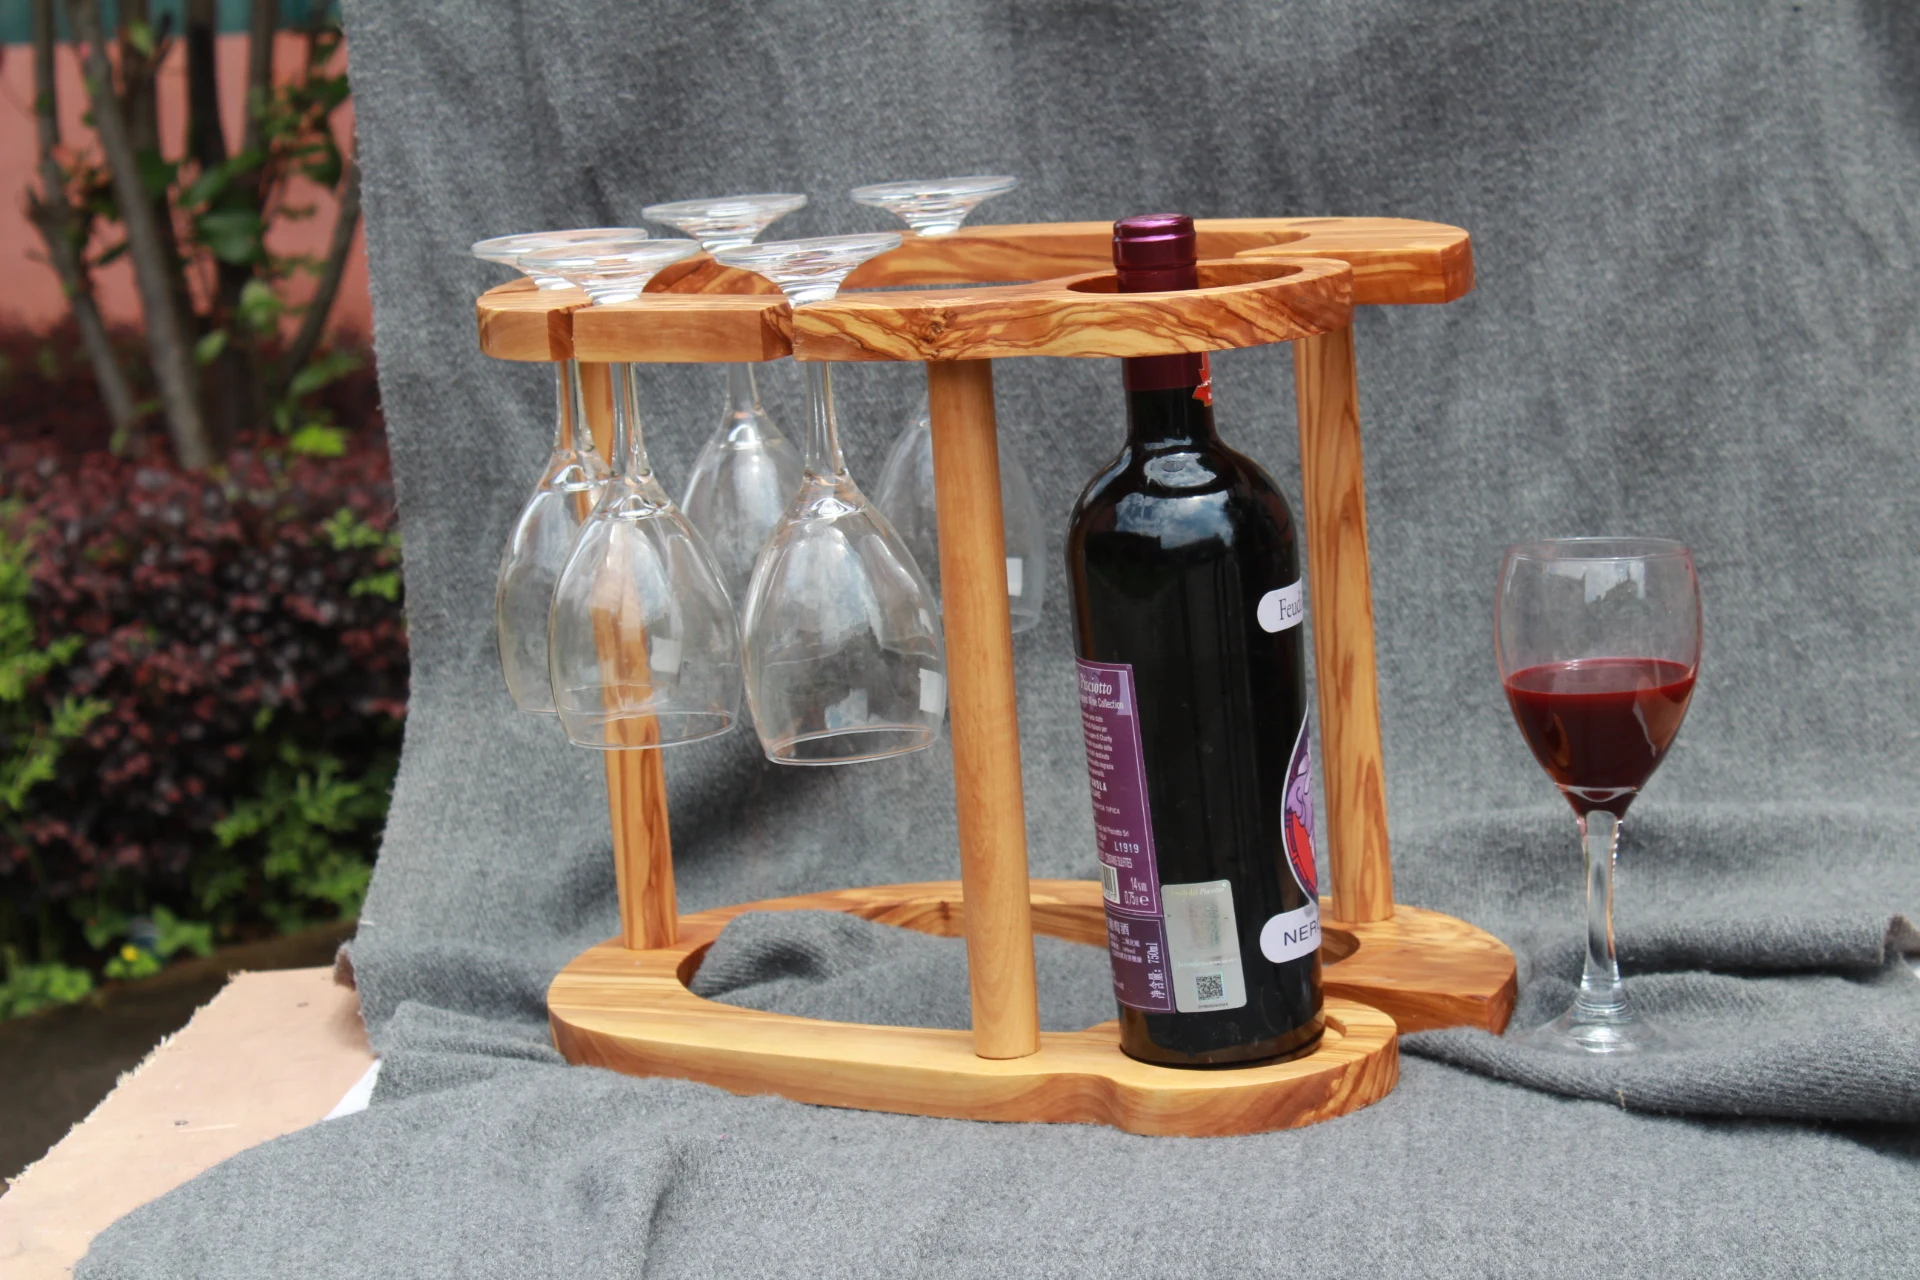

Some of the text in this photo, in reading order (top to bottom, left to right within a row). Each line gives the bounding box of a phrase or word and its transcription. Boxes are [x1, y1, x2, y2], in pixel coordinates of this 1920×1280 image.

[1098, 697, 1124, 709] Collection
[1113, 841, 1139, 854] L1919
[1145, 942, 1160, 964] 750ml
